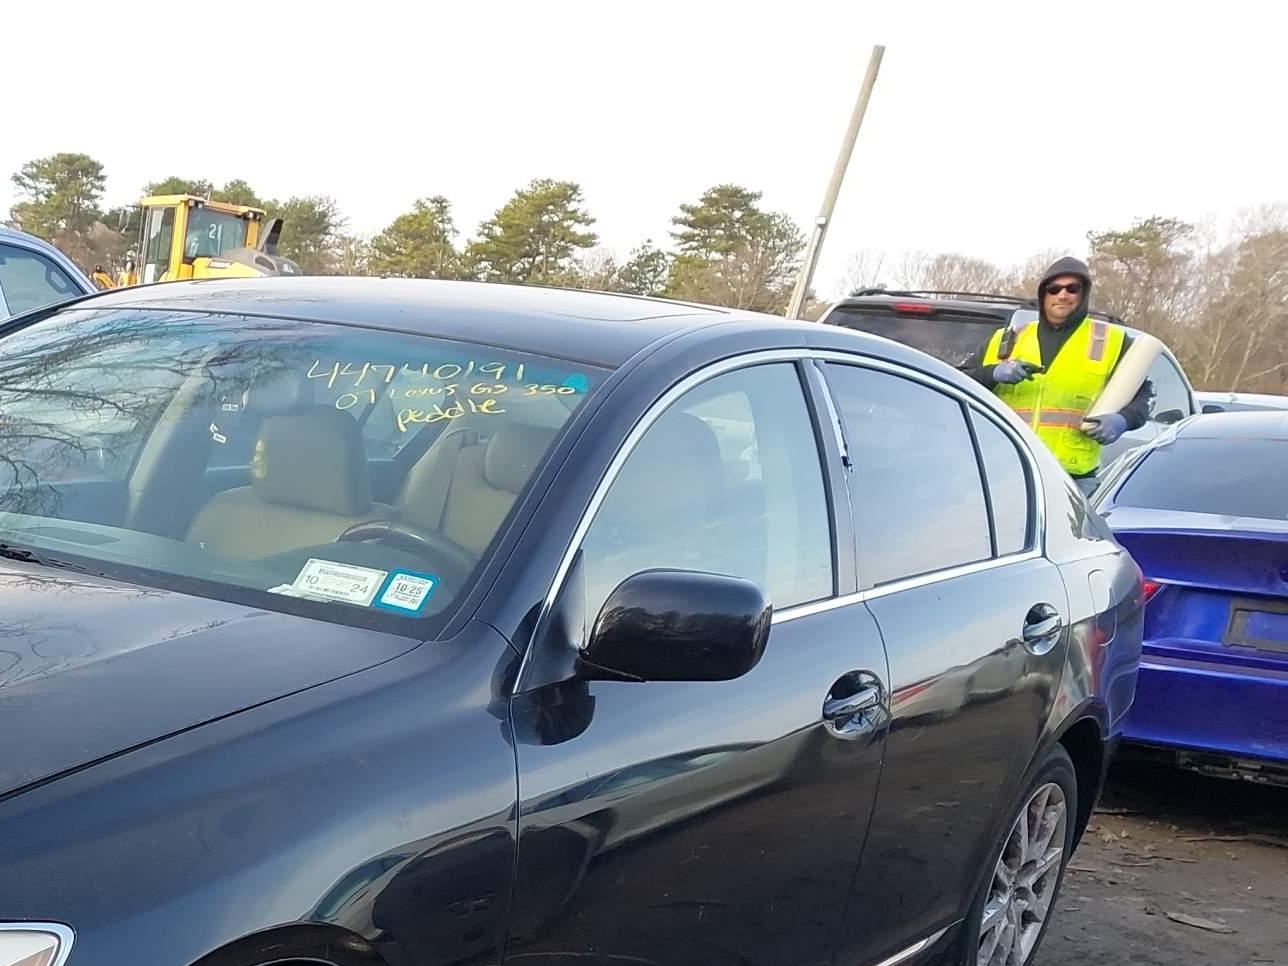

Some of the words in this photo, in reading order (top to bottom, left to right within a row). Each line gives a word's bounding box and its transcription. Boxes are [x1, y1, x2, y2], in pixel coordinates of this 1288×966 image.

[209, 223, 223, 240] 21
[307, 359, 524, 389] 44740191
[335, 388, 375, 410] 07
[524, 383, 576, 397] 350
[305, 574, 319, 585] 10
[350, 583, 369, 594] 24
